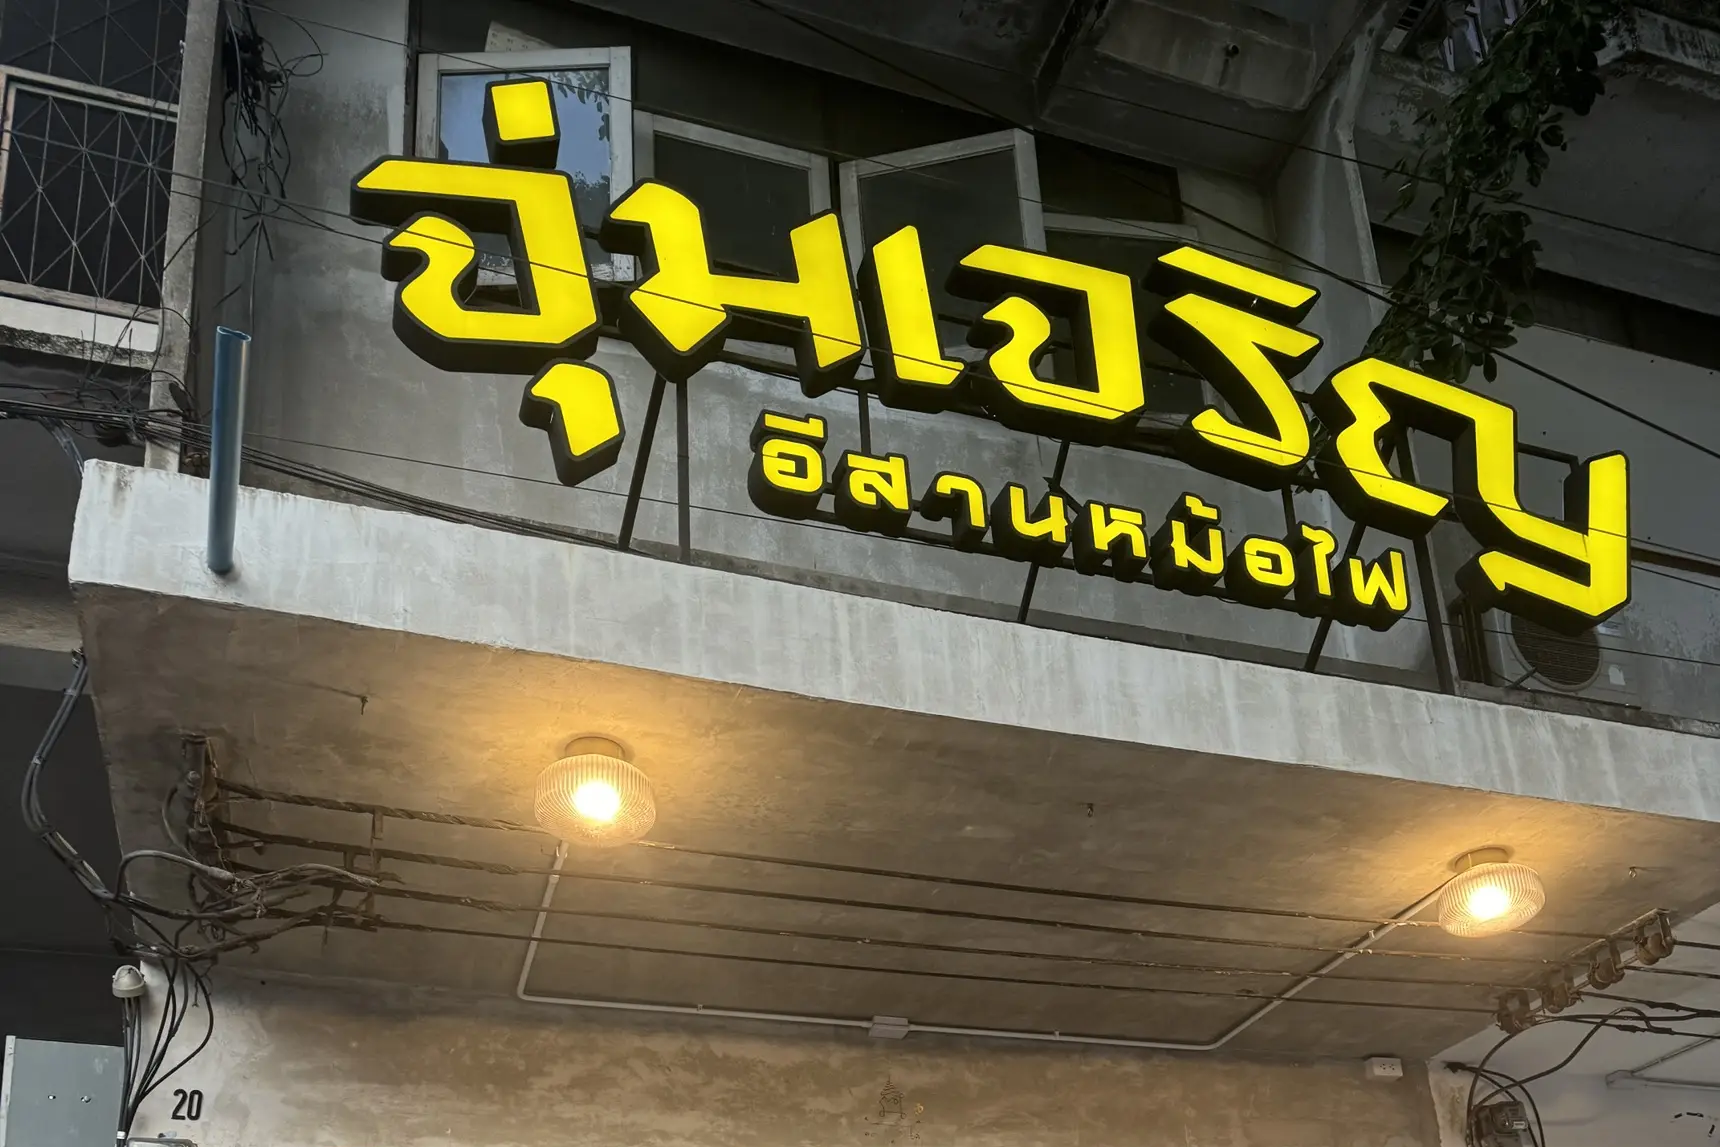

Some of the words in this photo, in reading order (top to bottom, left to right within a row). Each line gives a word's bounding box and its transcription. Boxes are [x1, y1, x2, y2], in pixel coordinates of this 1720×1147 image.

[355, 80, 1629, 619] จุ่มเจริญ
[762, 413, 1409, 613] อีสานหม้อไฟ
[171, 1088, 203, 1120] 20
